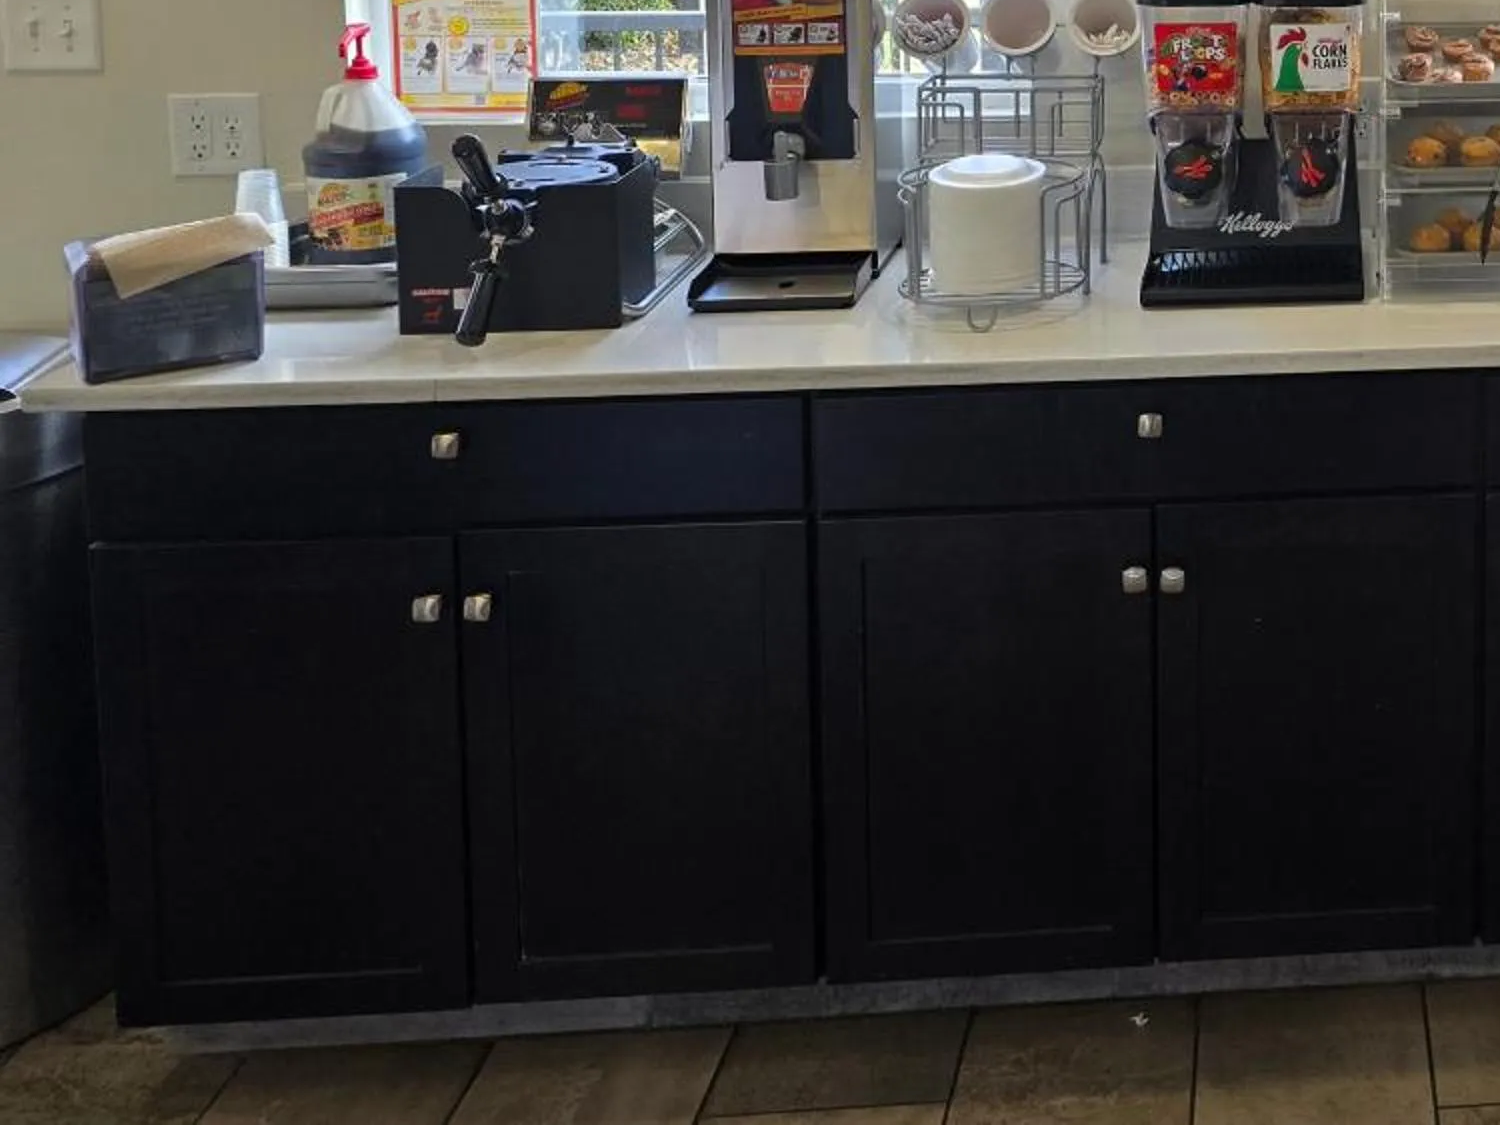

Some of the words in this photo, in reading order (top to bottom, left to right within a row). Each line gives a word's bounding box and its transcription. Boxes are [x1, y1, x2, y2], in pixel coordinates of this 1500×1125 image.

[1181, 46, 1226, 62] LOOPS
[1312, 44, 1348, 58] CORN
[1313, 57, 1348, 70] FLAKES
